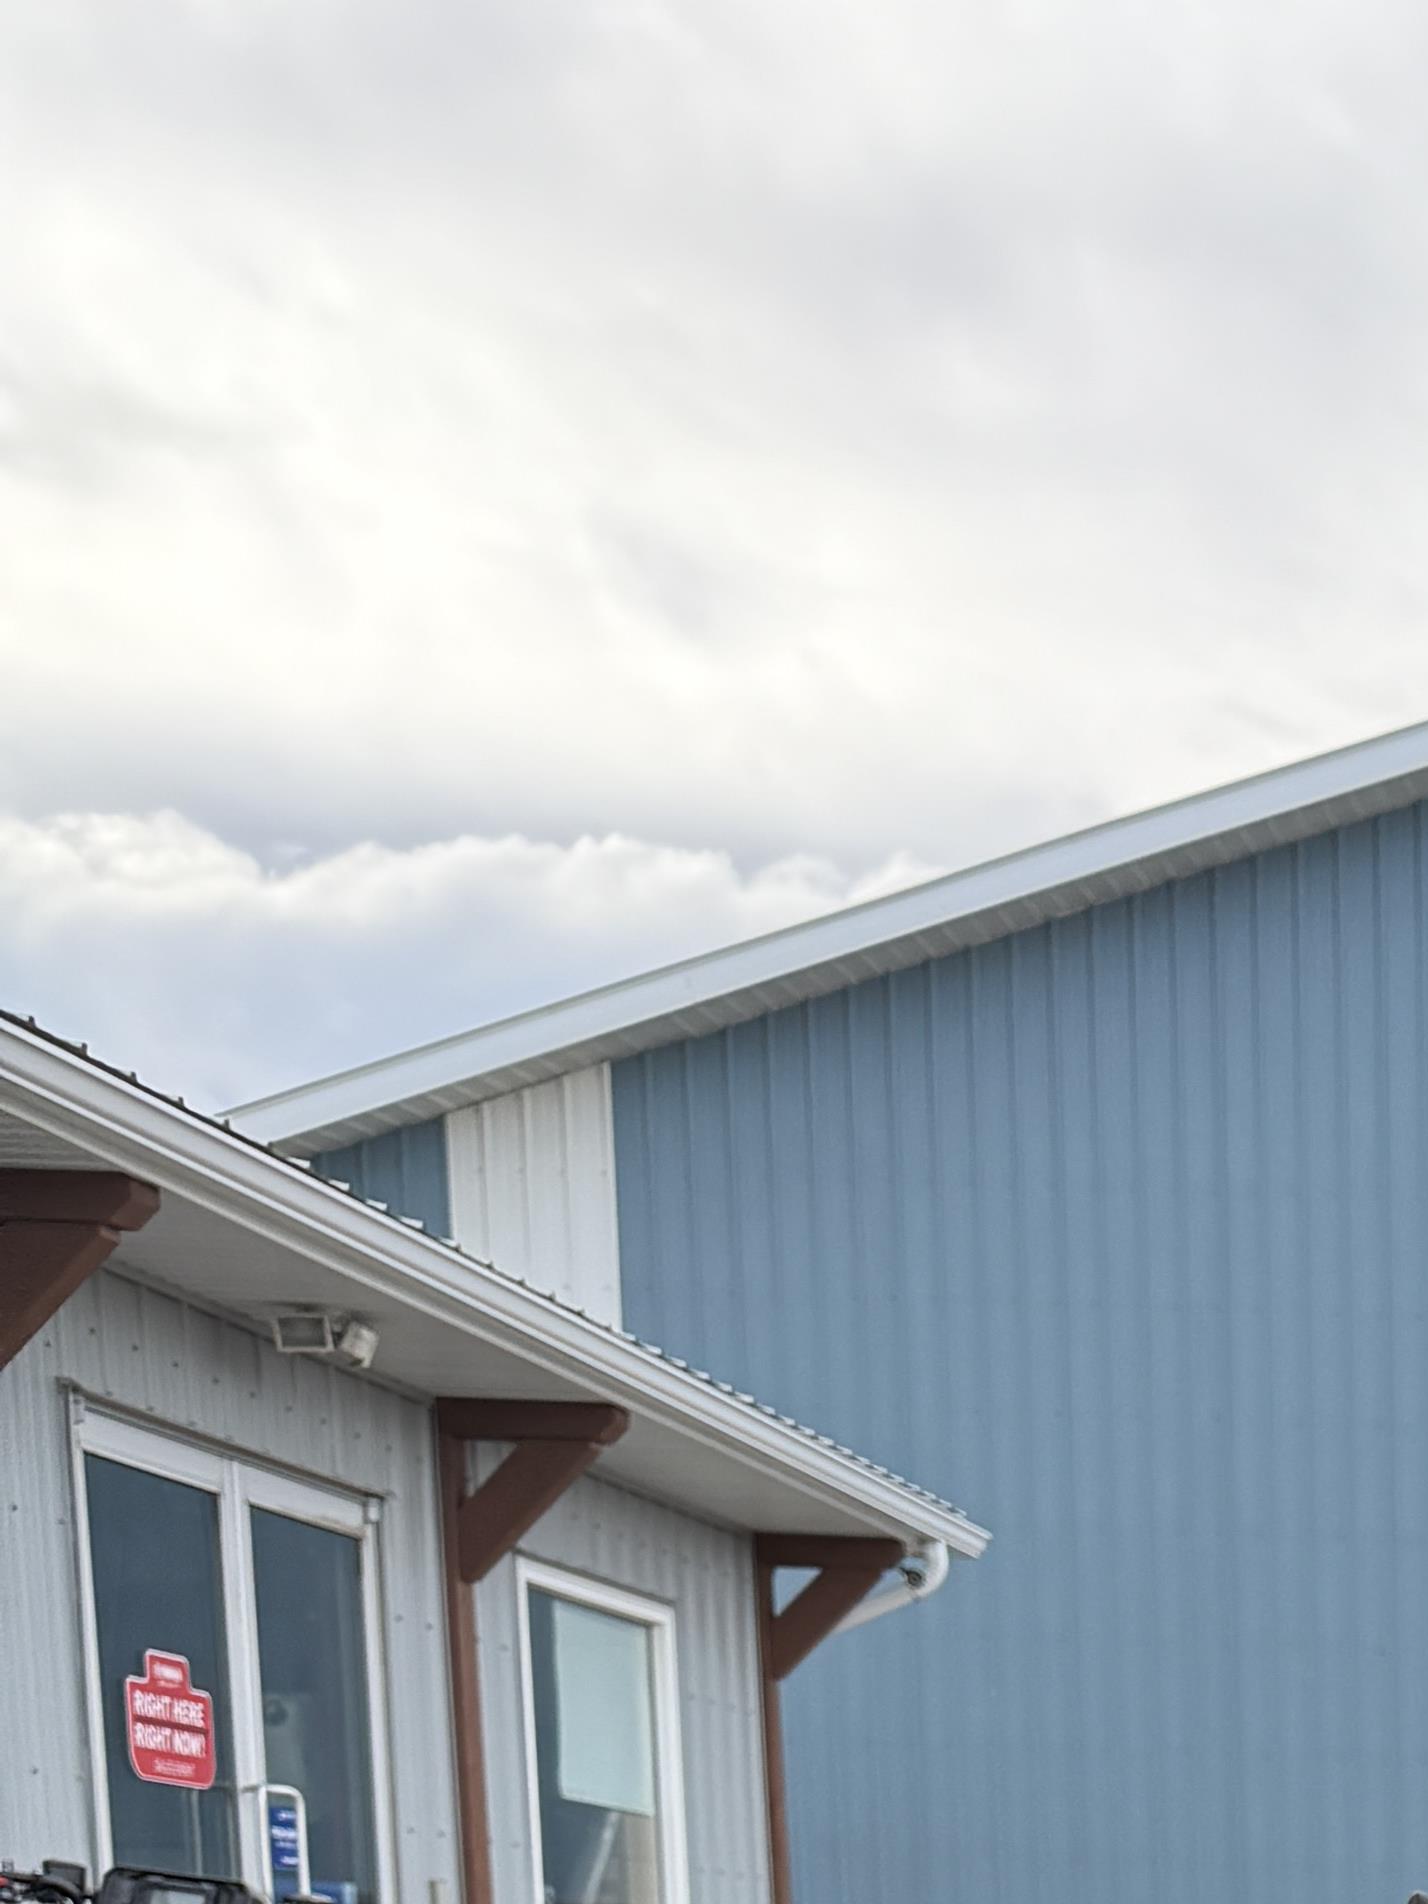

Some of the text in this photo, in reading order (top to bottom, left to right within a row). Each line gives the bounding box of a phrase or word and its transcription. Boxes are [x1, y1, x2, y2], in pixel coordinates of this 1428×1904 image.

[133, 1688, 205, 1729] RIGHT HERE
[134, 1721, 173, 1754] RIGHT
